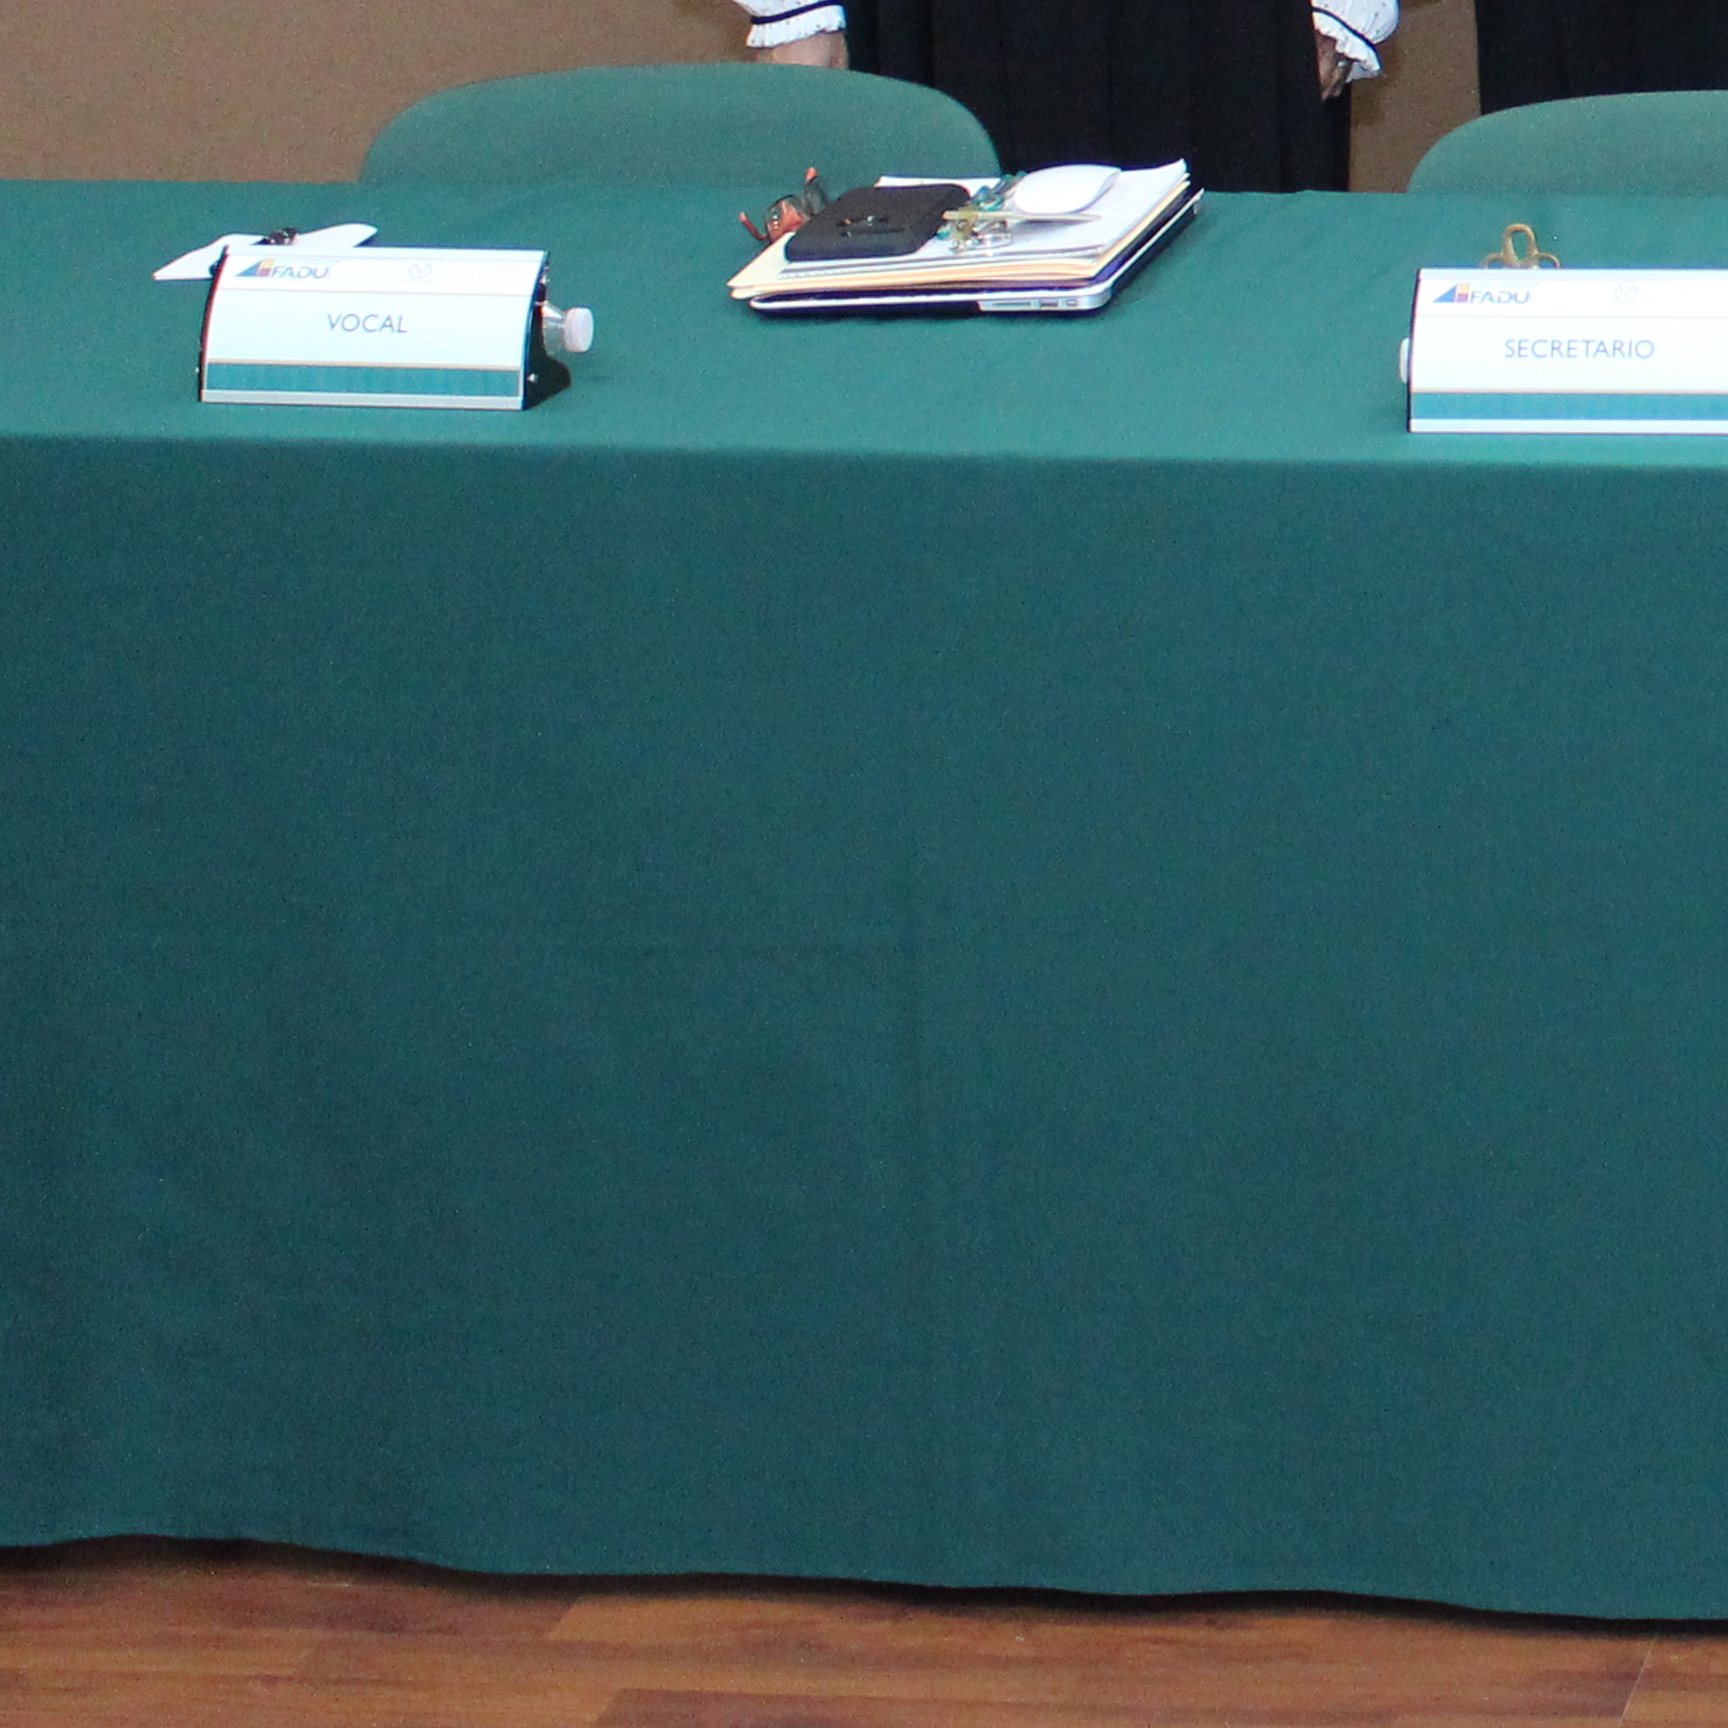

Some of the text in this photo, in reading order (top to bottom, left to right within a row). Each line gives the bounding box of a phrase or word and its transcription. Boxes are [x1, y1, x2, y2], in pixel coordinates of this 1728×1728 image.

[270, 265, 331, 280] FADU
[1469, 289, 1531, 304] FADU
[326, 313, 409, 334] VOCAL
[1504, 338, 1656, 359] SECRETARIO
